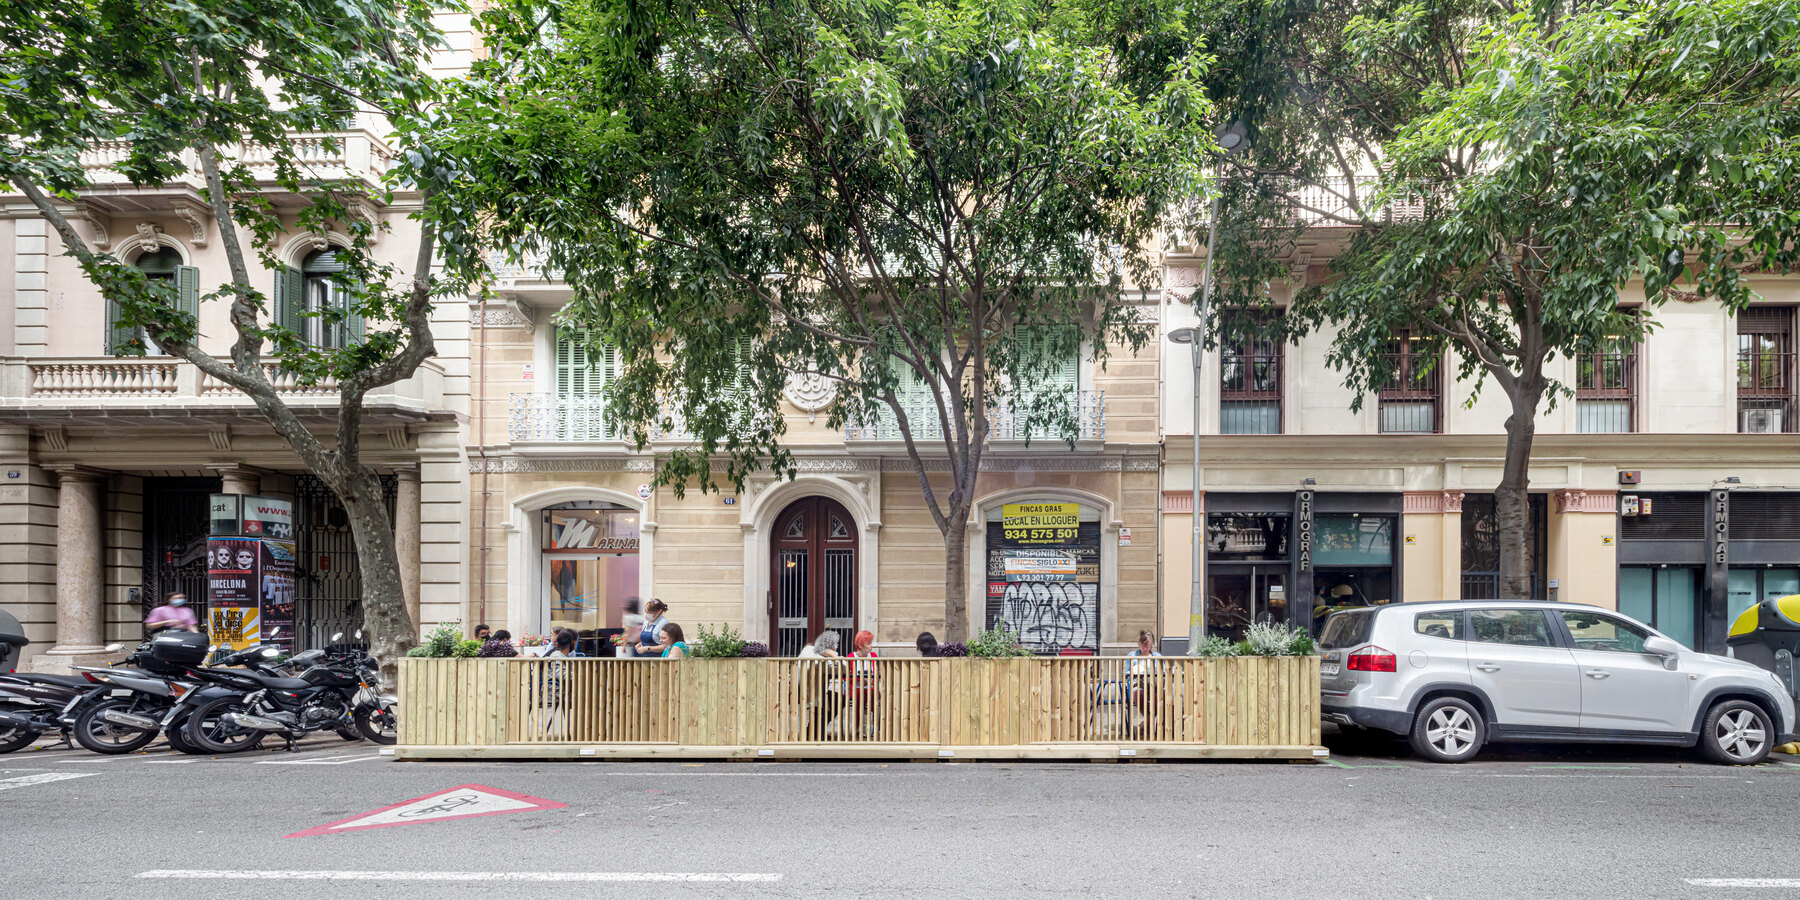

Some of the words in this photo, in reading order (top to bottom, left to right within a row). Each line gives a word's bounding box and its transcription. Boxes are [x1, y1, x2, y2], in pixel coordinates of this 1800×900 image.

[1020, 505, 1042, 513] FINCAS
[1004, 517, 1028, 526] LOCAL
[1030, 517, 1041, 525] EN
[1042, 516, 1077, 525] LLOGUER
[1300, 491, 1311, 571] ORMOGRAF
[1715, 491, 1727, 563] ORMOLAB
[1004, 530, 1027, 539] 934
[1031, 530, 1053, 539] 575
[1057, 529, 1078, 538] 501
[210, 579, 247, 589] BARCELONA
